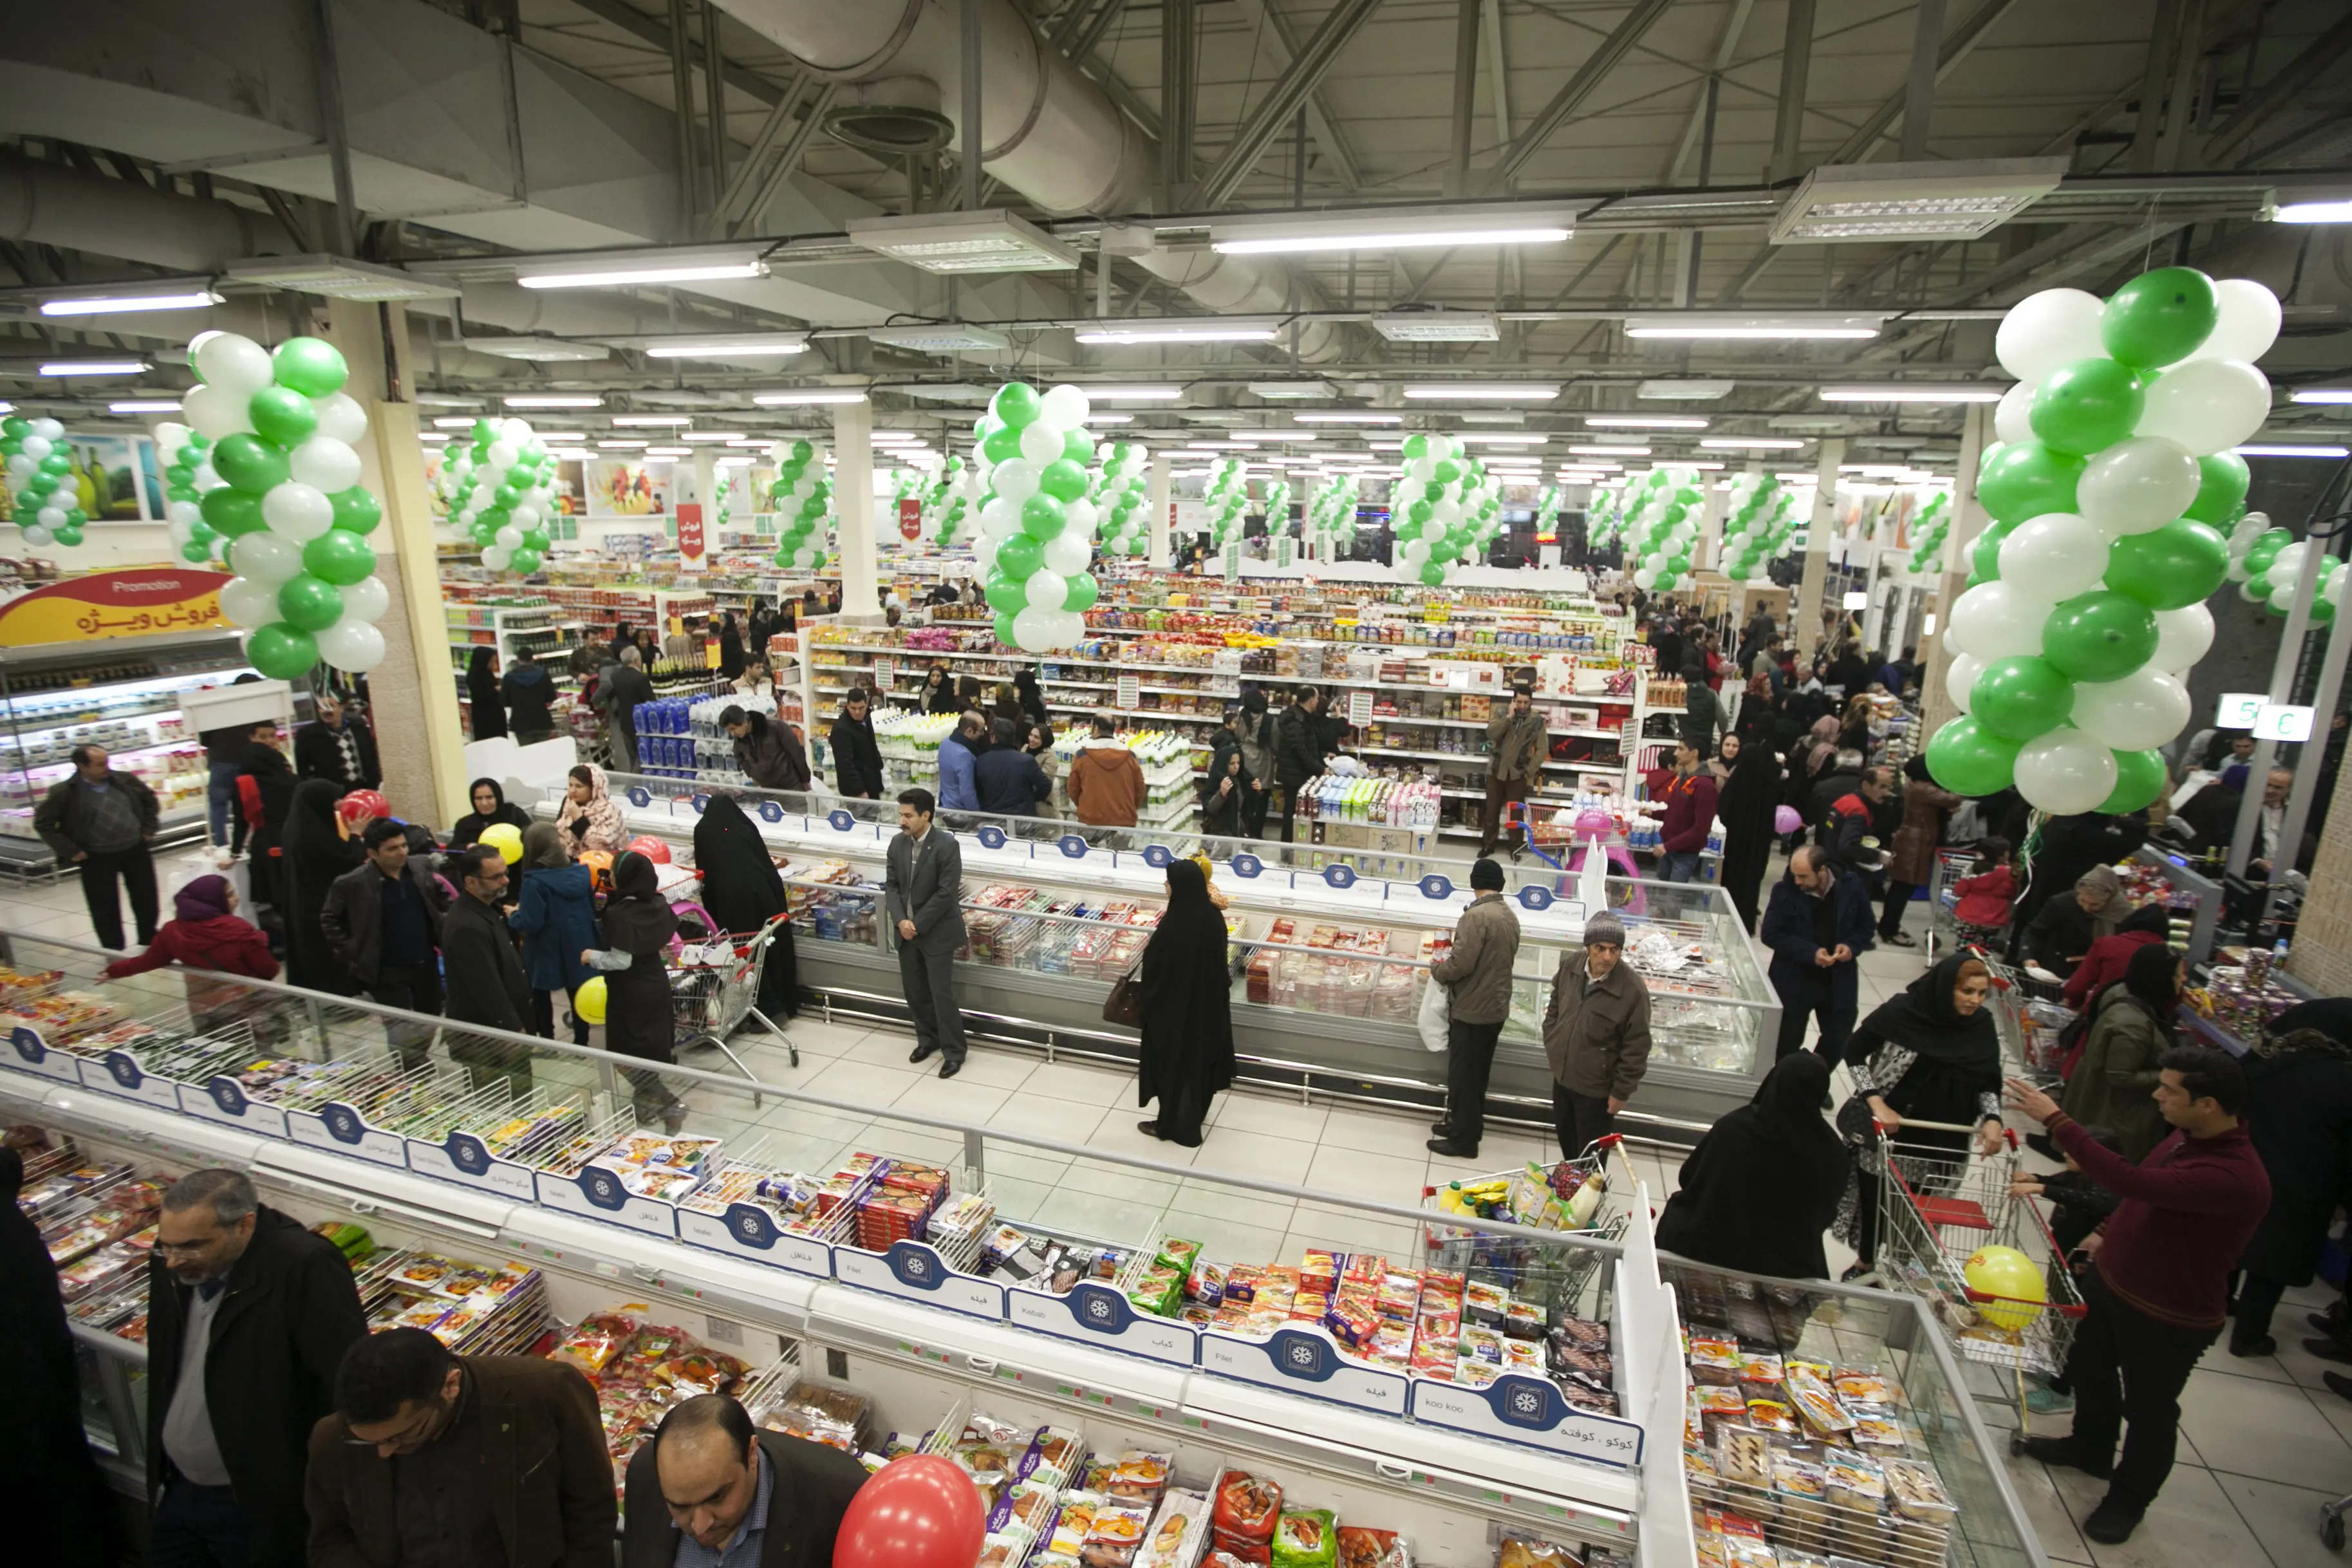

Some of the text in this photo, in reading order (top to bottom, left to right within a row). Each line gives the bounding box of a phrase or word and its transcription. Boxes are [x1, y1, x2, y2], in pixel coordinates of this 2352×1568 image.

[112, 580, 182, 593] Promotion
[76, 601, 220, 635] فروش ویژه
[2239, 702, 2257, 722] 5
[2278, 713, 2295, 734] 6
[847, 1265, 861, 1274] Filet
[1206, 1282, 1218, 1292] 202
[970, 1294, 987, 1305] فیله
[1022, 1307, 1046, 1318] Kebab
[1152, 1338, 1173, 1349] کباب
[1215, 1352, 1233, 1363] Filet
[1366, 1386, 1386, 1398] فیله
[1425, 1397, 1464, 1414] koo koo
[1560, 1427, 1596, 1442] کوفته
[1607, 1437, 1634, 1450] کوکو
